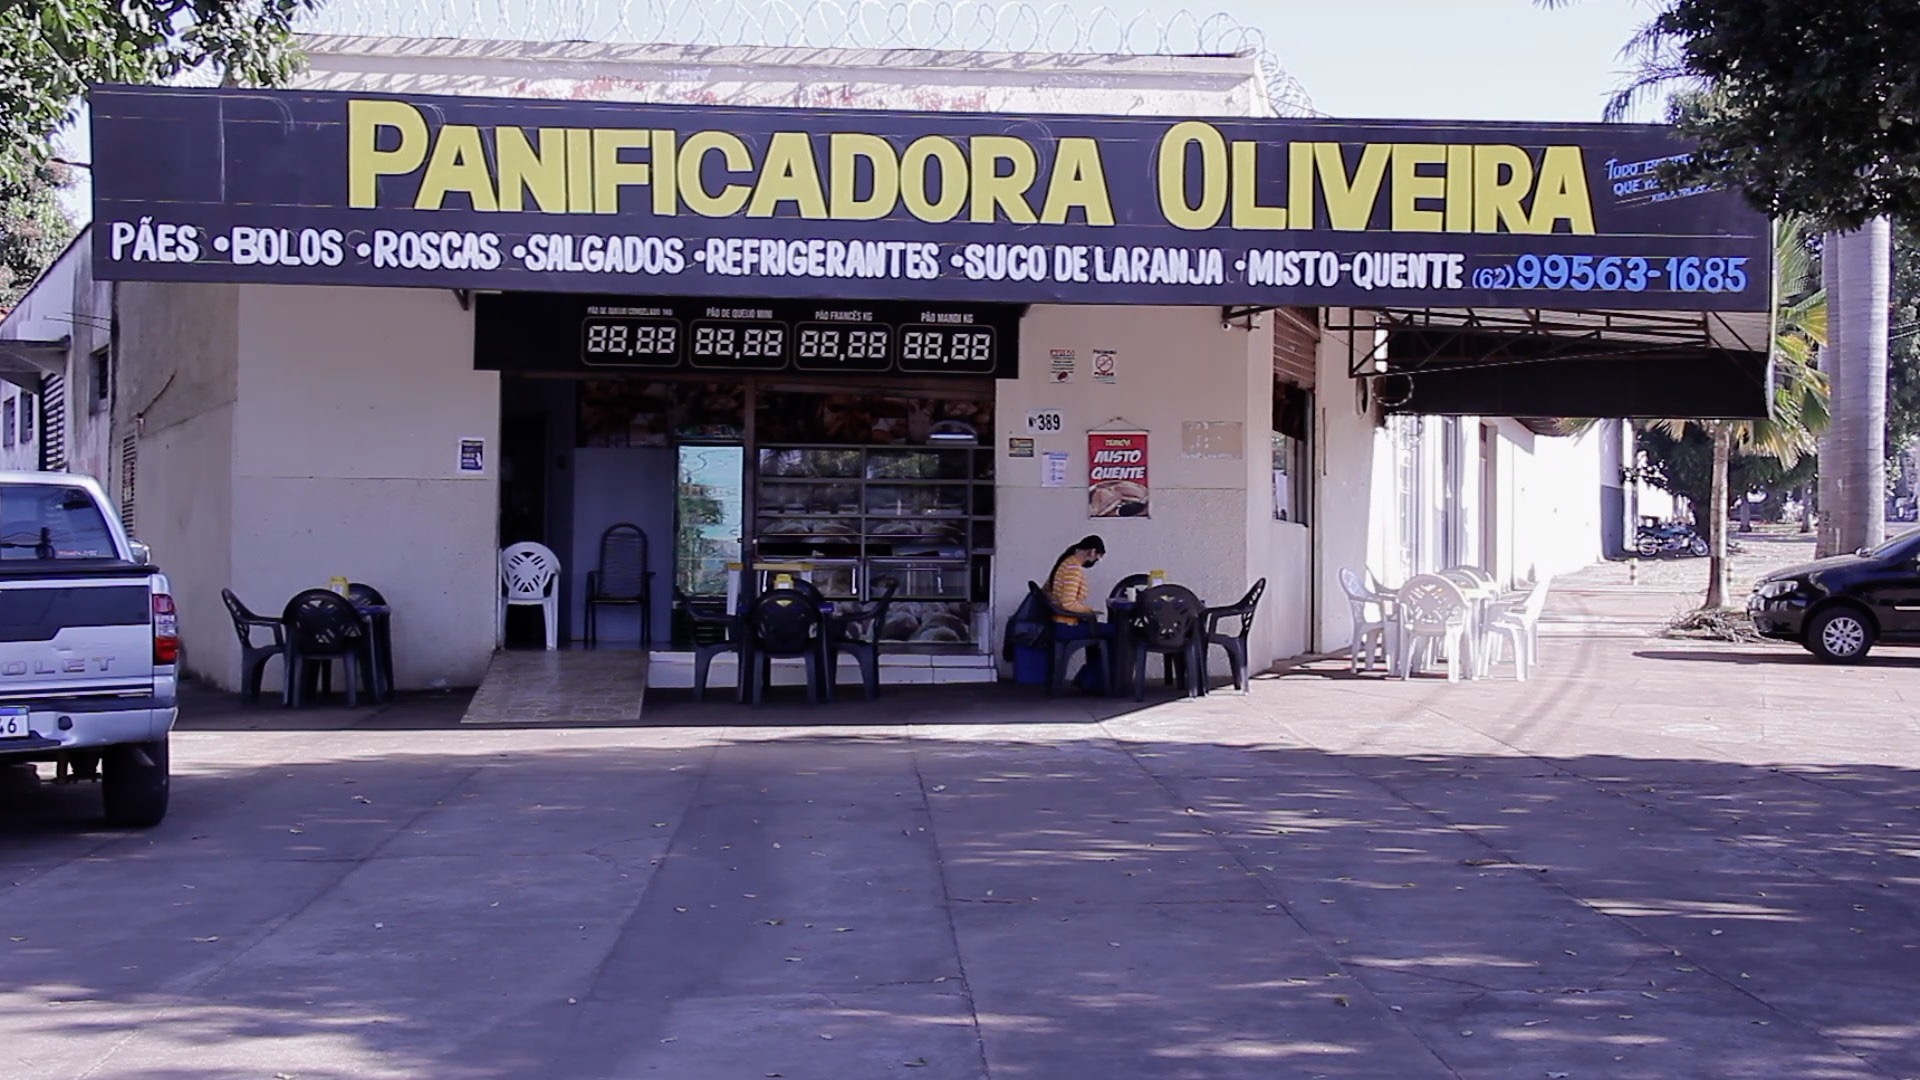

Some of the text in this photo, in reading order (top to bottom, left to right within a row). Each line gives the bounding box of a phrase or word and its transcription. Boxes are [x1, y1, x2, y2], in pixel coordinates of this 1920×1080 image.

[348, 99, 1596, 235] PANIFICADORA OLIVEIRA
[111, 217, 199, 263] PÃES
[1053, 246, 1090, 282] DE
[1095, 246, 1224, 285] LARANJA
[1516, 253, 1750, 293] 99563-1685
[1037, 414, 1061, 431] 389
[1093, 449, 1142, 463] MISTO
[1091, 466, 1146, 480] QUENTE
